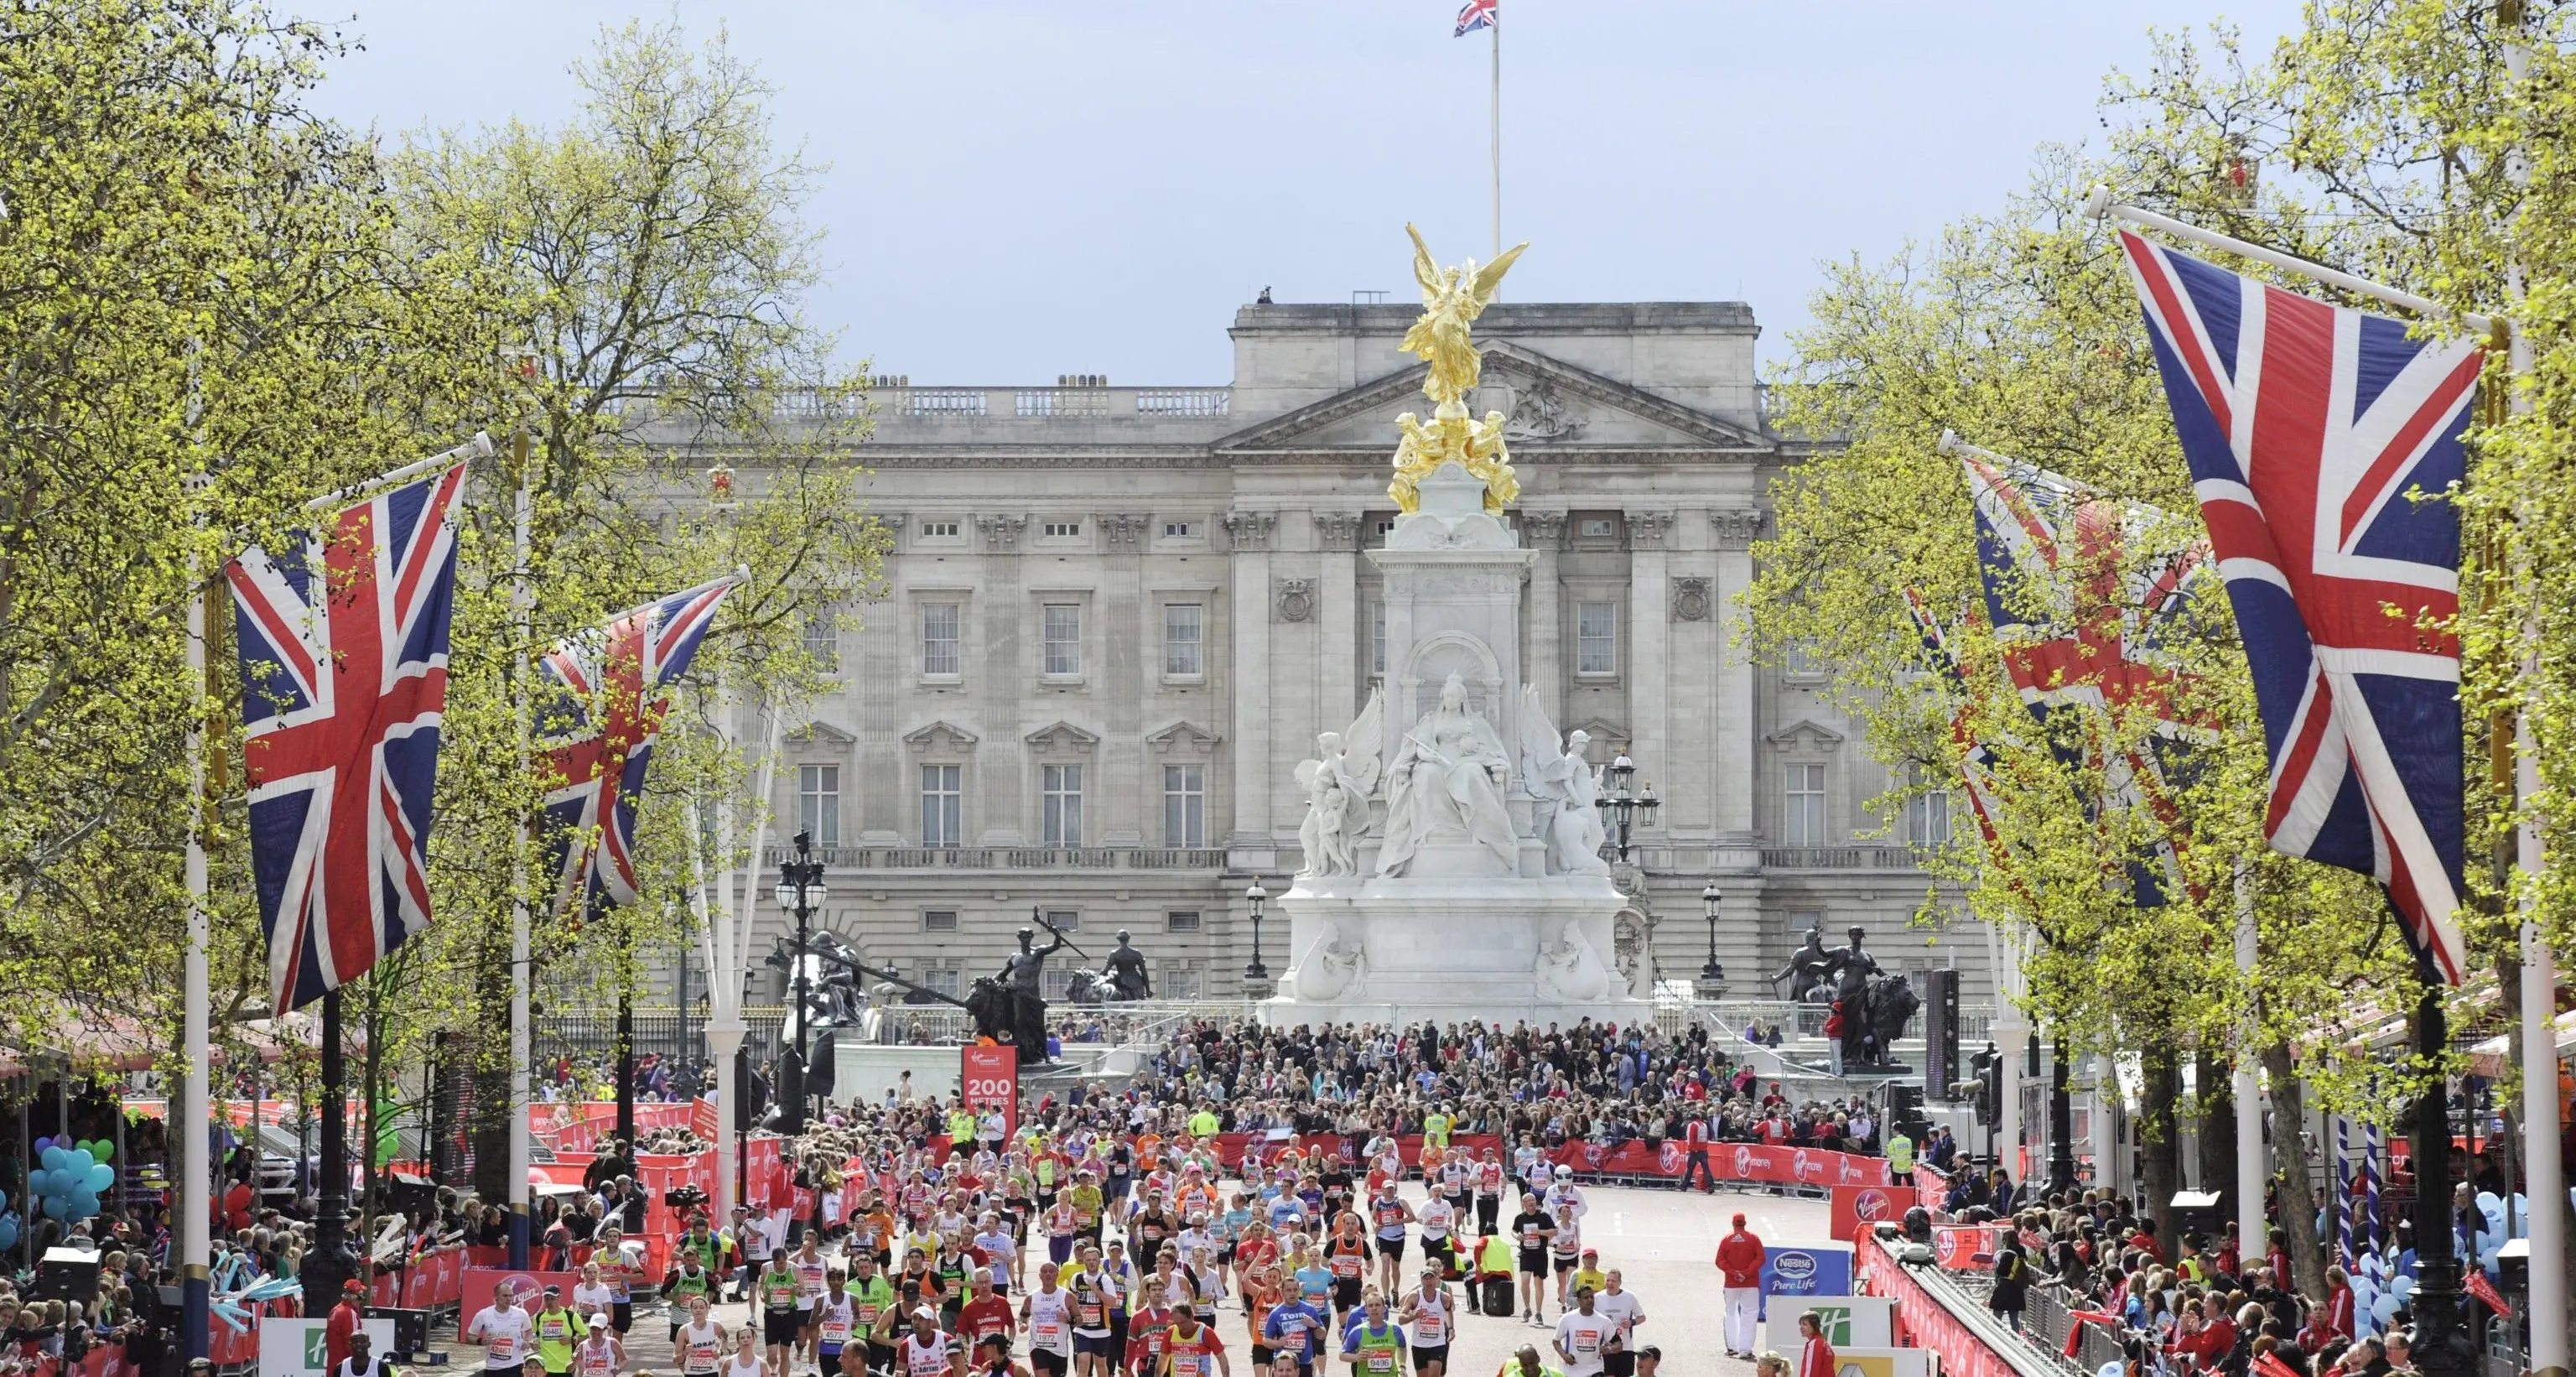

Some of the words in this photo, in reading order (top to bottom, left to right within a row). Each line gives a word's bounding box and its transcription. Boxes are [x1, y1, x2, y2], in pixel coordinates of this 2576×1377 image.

[969, 1079, 1011, 1096] 200
[970, 1097, 1009, 1105] METRES
[1751, 1158, 1771, 1168] money
[1806, 1161, 1824, 1173] money
[1858, 1193, 1887, 1219] Virgin
[1772, 1280, 1796, 1291] Pure
[1797, 1279, 1815, 1290] Life
[918, 1365, 938, 1374] Adrian
